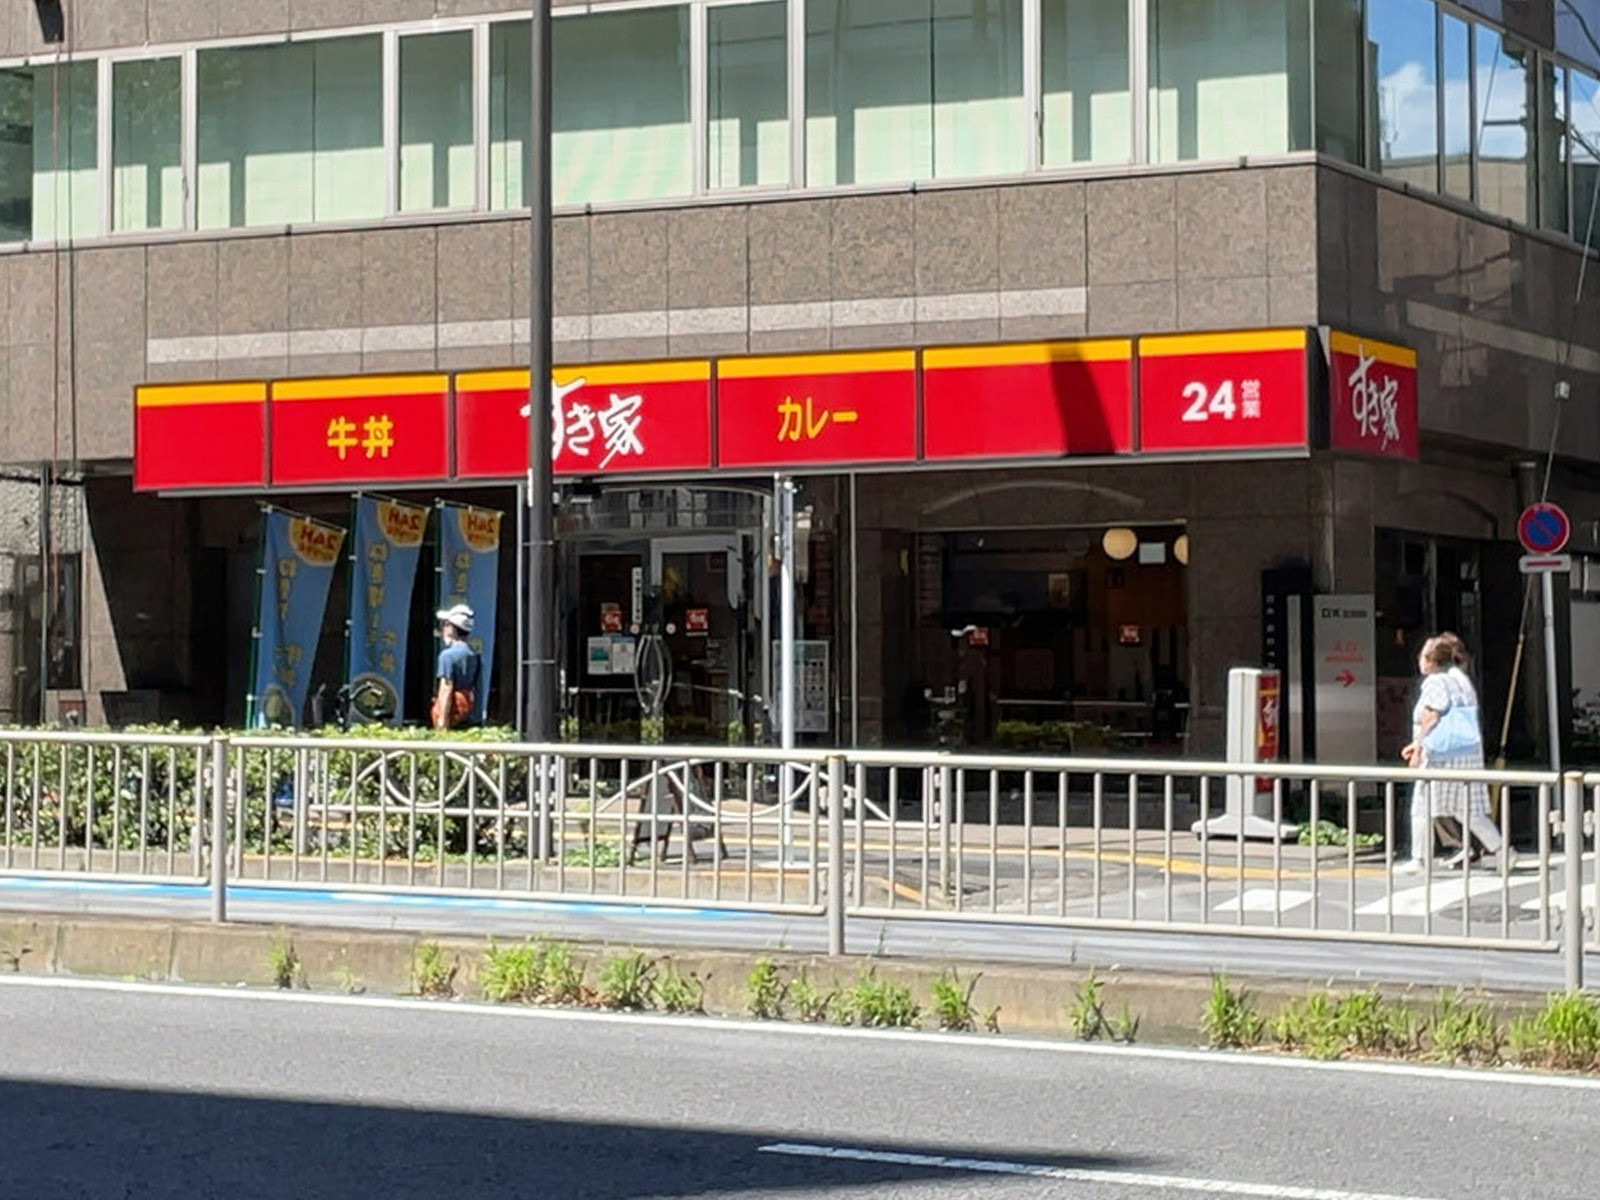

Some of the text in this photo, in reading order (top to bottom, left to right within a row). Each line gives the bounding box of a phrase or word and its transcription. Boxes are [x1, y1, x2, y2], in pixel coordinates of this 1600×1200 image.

[777, 396, 857, 441] カレー
[1181, 380, 1236, 421] 24
[1348, 344, 1399, 450] すき家
[327, 414, 394, 460] 牛丼
